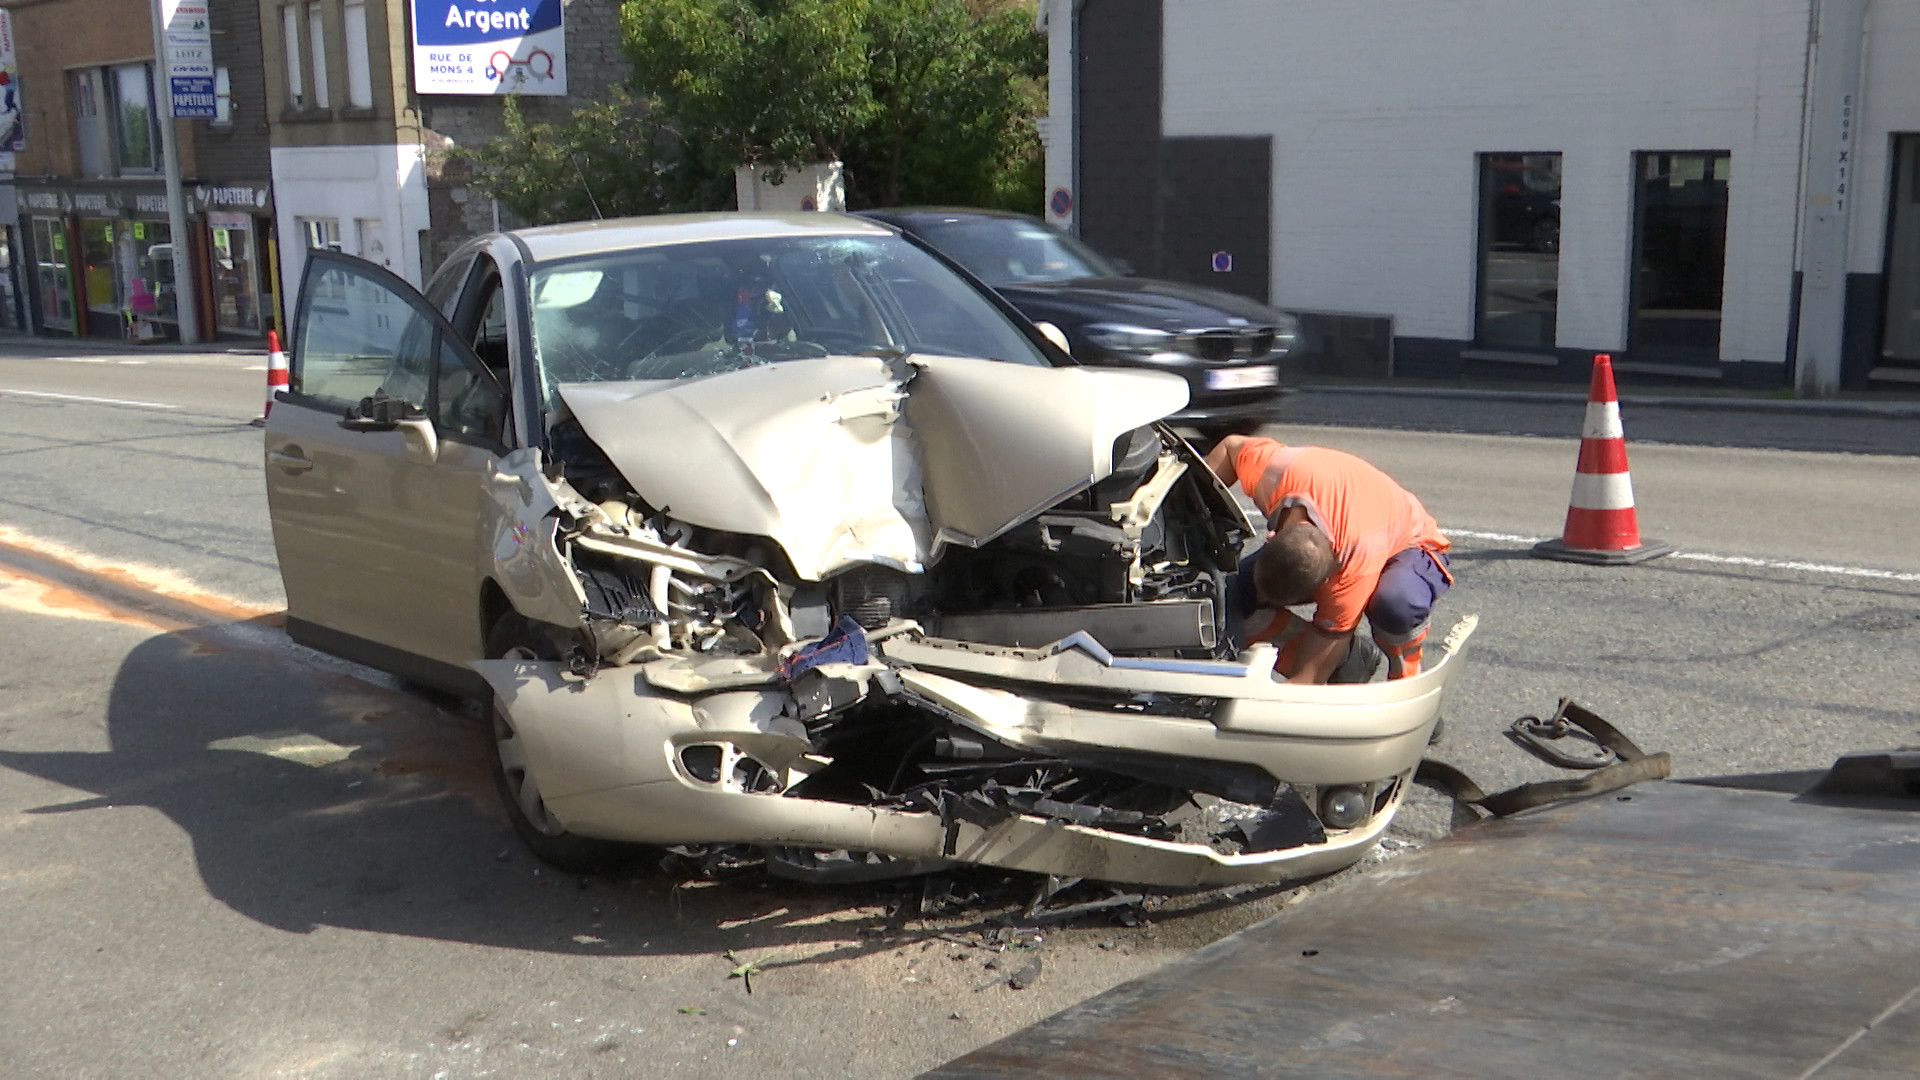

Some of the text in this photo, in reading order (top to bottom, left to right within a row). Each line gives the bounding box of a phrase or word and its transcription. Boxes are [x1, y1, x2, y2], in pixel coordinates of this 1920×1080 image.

[445, 5, 530, 33] Argent
[430, 53, 473, 62] RUE DE
[430, 65, 463, 74] MONS
[174, 93, 214, 106] PAPETERIE
[1837, 151, 1848, 211] X141
[213, 187, 254, 206] PAPETERIE
